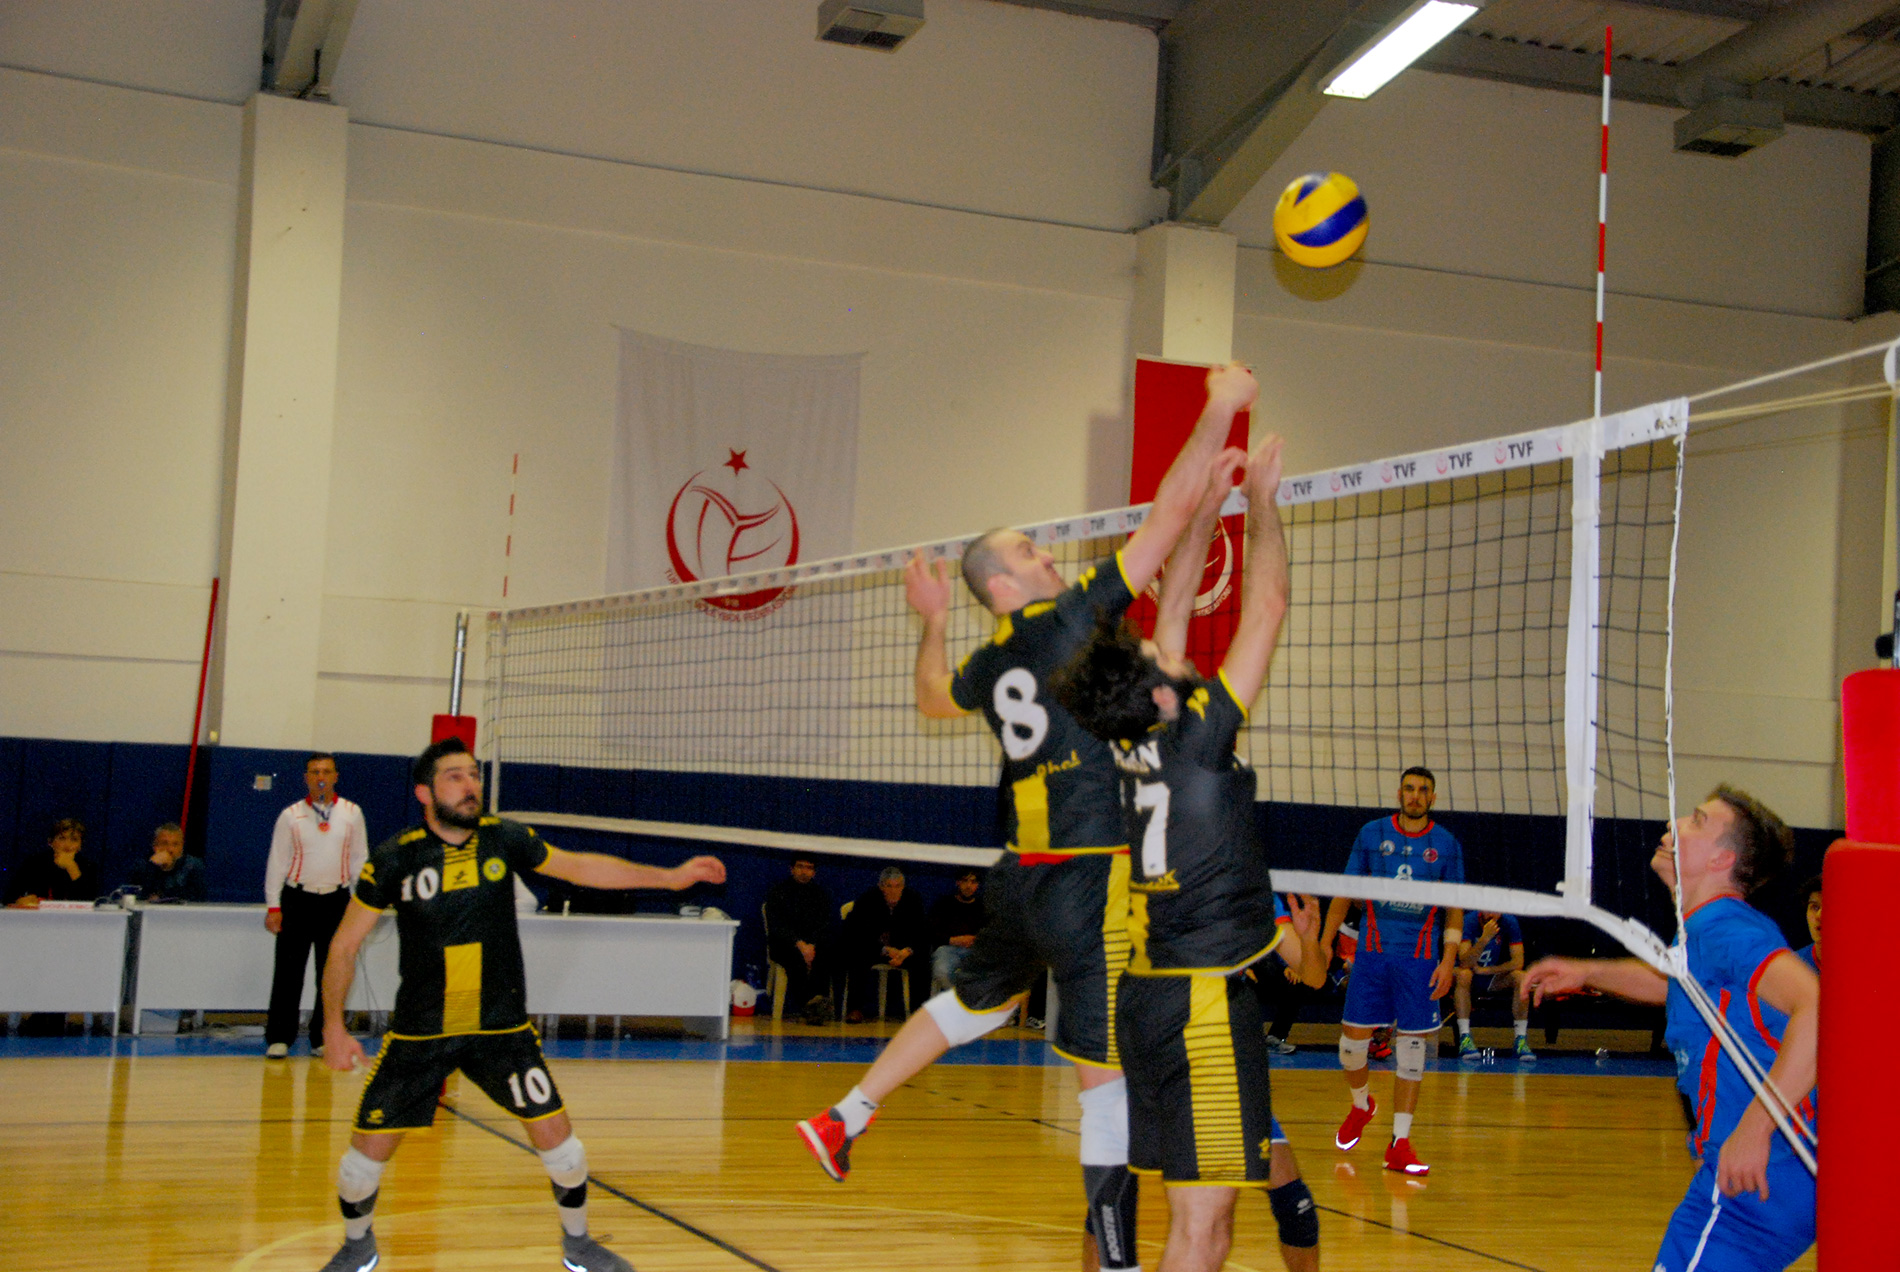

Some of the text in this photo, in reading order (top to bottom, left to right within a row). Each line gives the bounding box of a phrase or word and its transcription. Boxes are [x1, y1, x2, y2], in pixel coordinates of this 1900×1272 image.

[1292, 480, 1313, 497] TVF
[1340, 471, 1363, 489] TVF
[1393, 461, 1417, 480] TVF
[1448, 451, 1474, 471] TVF
[1507, 440, 1535, 461] TVF
[993, 667, 1049, 761] 8
[401, 866, 440, 902] 10
[508, 1066, 552, 1108] 10
